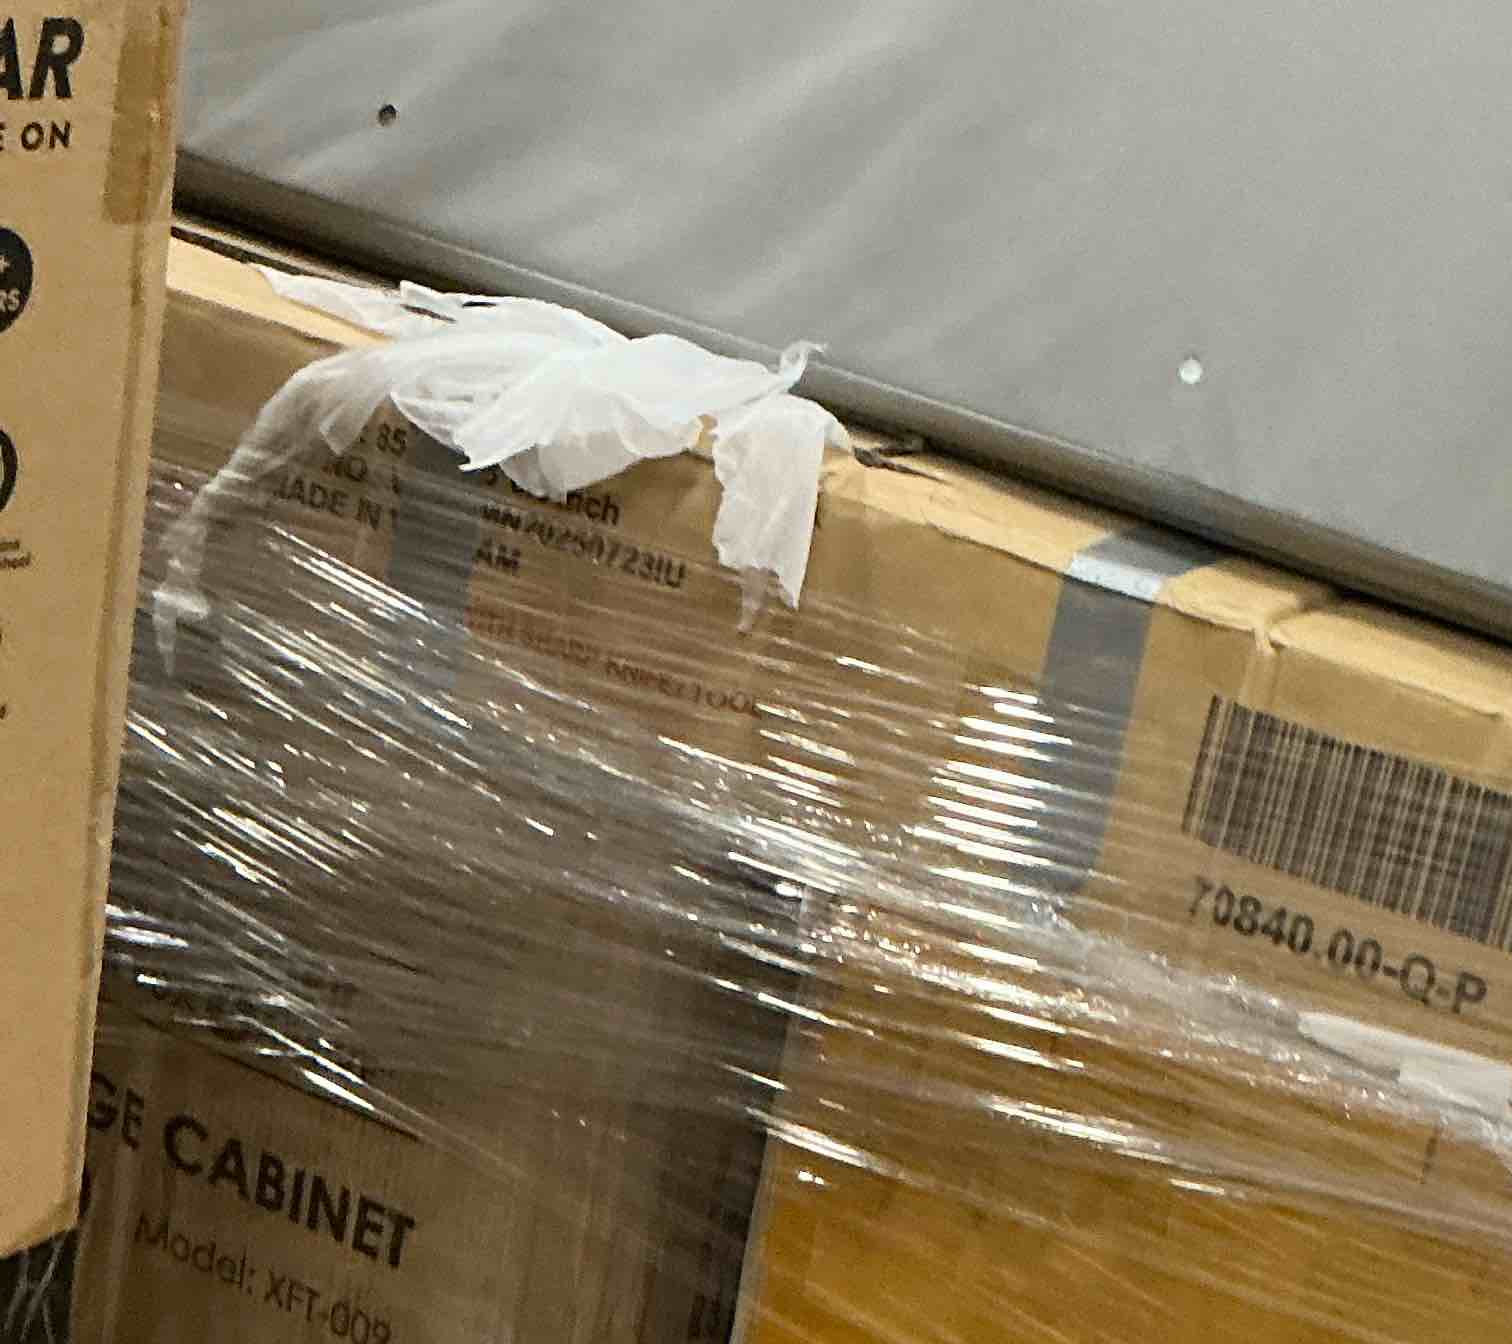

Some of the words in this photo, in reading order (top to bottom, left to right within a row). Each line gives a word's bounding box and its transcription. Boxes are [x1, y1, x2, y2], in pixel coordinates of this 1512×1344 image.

[20, 121, 72, 151] ON
[1188, 874, 1488, 1014] 70840.00-Q-P
[163, 1113, 416, 1269] CABINET
[134, 1209, 256, 1297] Model:
